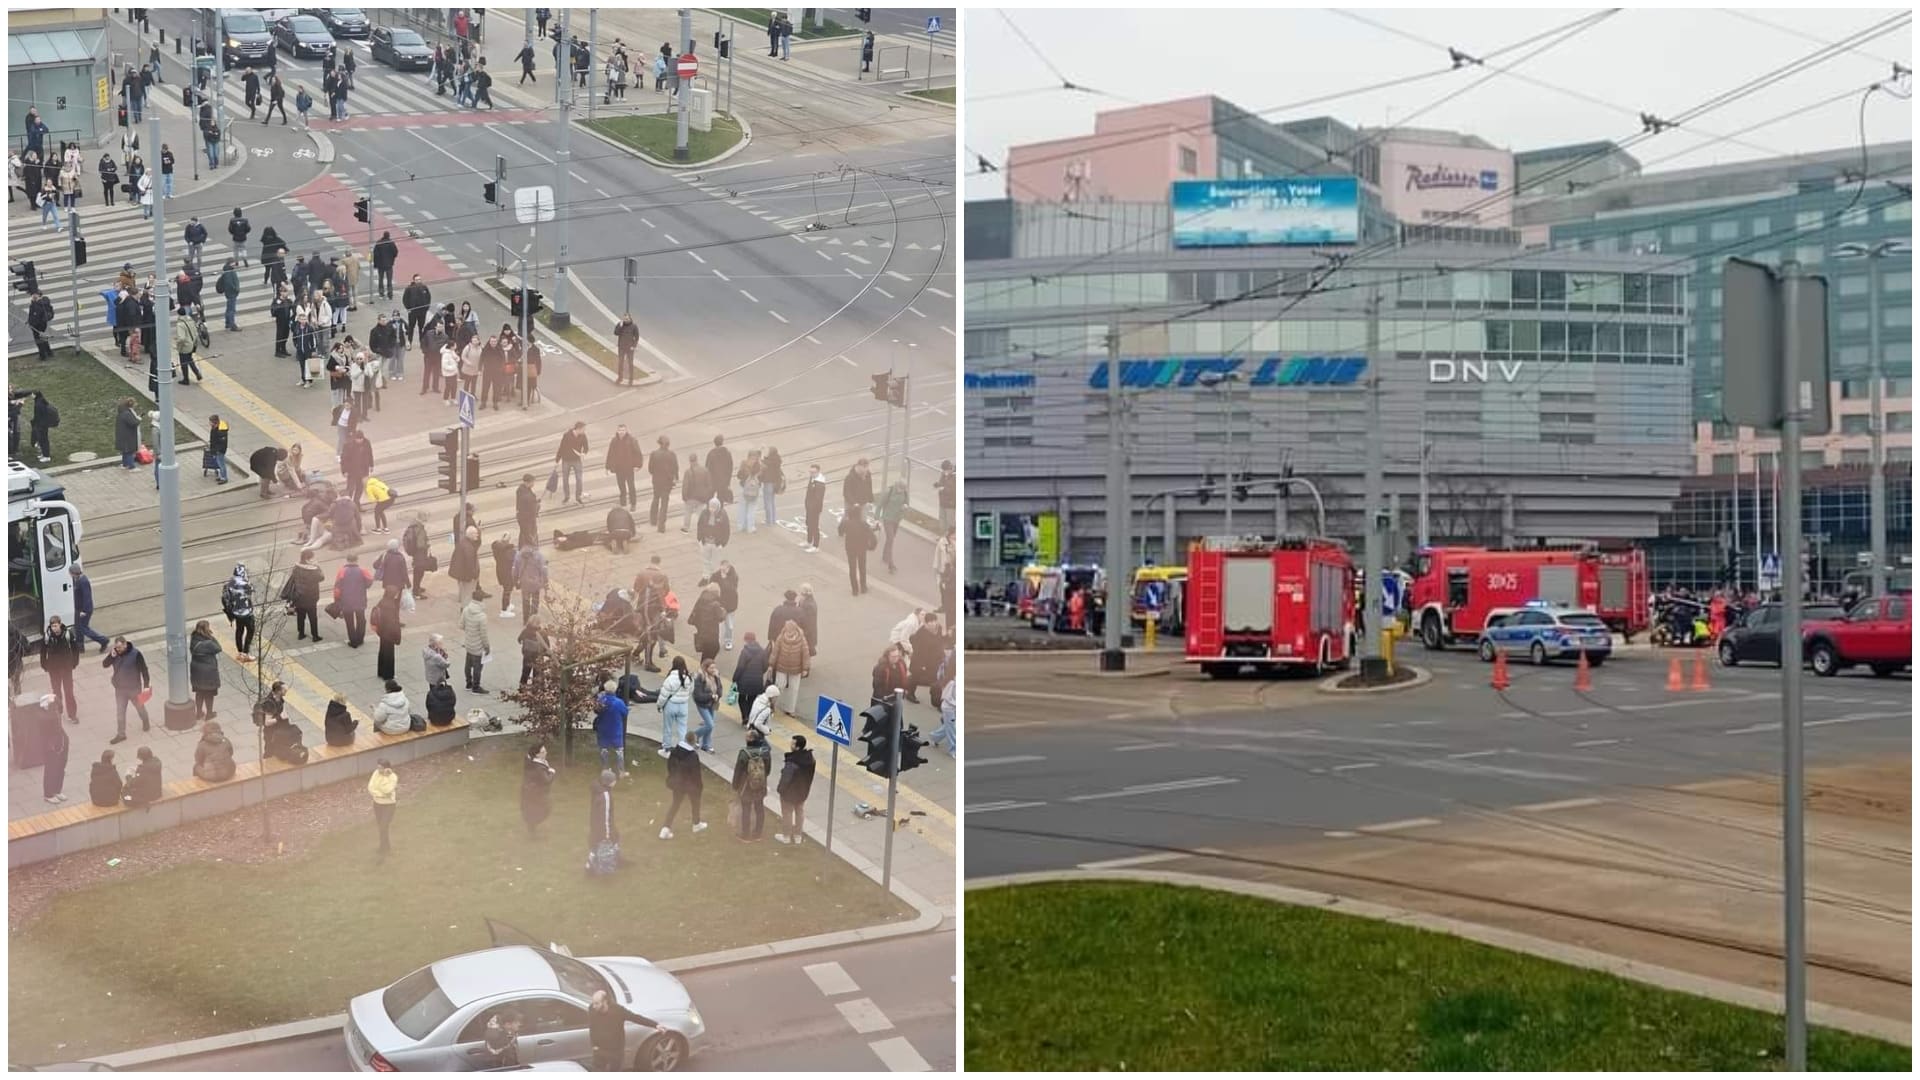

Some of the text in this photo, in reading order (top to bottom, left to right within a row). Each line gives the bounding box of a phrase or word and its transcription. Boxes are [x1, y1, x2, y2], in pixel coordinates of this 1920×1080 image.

[1088, 356, 1368, 388] UNITY LINE
[1430, 360, 1522, 382] DNV
